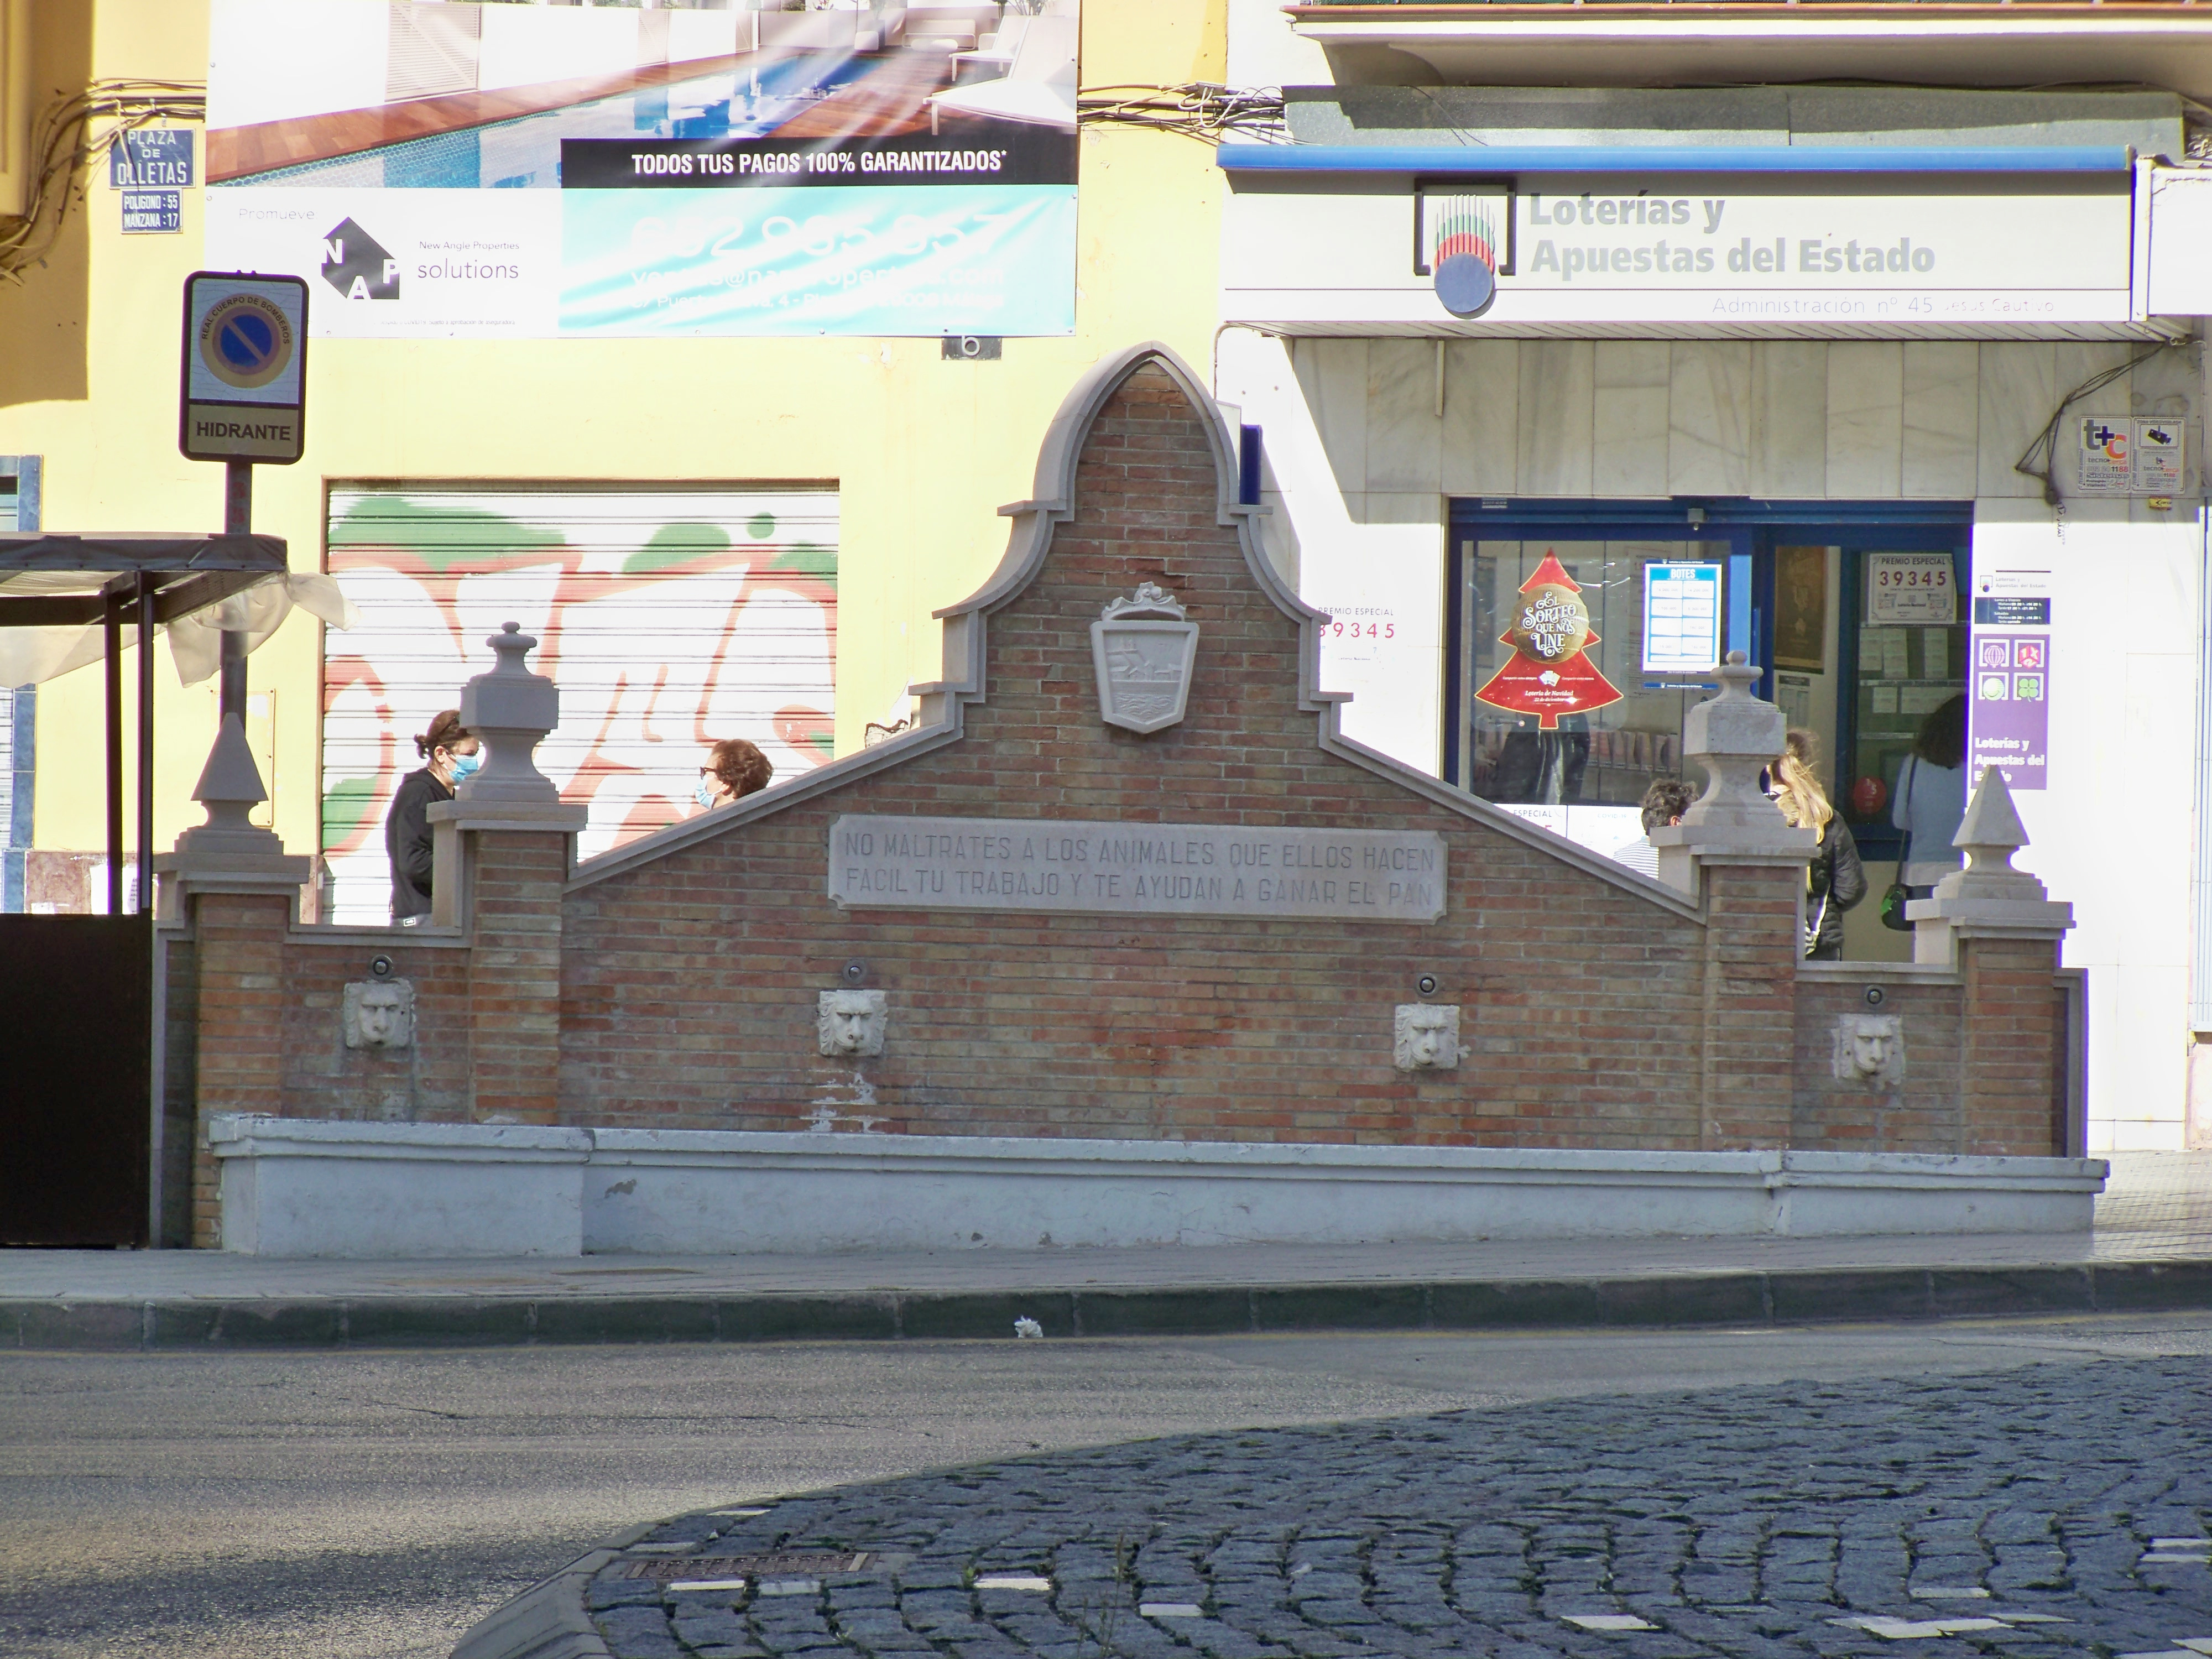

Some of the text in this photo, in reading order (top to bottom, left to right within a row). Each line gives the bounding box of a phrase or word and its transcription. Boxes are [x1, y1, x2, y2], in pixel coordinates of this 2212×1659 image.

[128, 131, 176, 144] PLAZA
[142, 149, 160, 158] DE
[632, 154, 692, 174] TODOS
[697, 154, 734, 173] TUS
[739, 153, 800, 173] PAGOS
[807, 152, 855, 172] 100%
[118, 162, 186, 185] OLLETAS
[168, 195, 178, 208] 55
[168, 213, 178, 227] 17
[239, 208, 318, 220] Promueve:
[1530, 189, 1725, 234] Loterías y
[420, 241, 520, 252] New Angle Properties
[1530, 237, 1935, 281] Apuestas del Estado
[418, 259, 519, 279] solutions
[1713, 296, 1865, 313] Administración
[1908, 297, 1932, 312] 45
[202, 316, 213, 339] REAL
[212, 296, 244, 315] CUERPO
[261, 301, 289, 344] BOMBEROS
[196, 421, 291, 441] HIDRANTE
[1671, 568, 1695, 579] BOTES
[1880, 571, 1947, 586] 39345
[1536, 591, 1559, 609] EL
[1522, 604, 1577, 629] SORTEO
[1536, 617, 1575, 635] QUE NOS
[1975, 737, 2030, 752] Loterías y
[1974, 754, 2045, 768] Apuestas del
[846, 833, 1434, 872] NO MALTRATES A LOS ANIMALES QUE ELLOS HACEN
[846, 868, 1431, 906] FACIL TU TRABAJO Y TE AYUDAN A GANAR EL PAN
